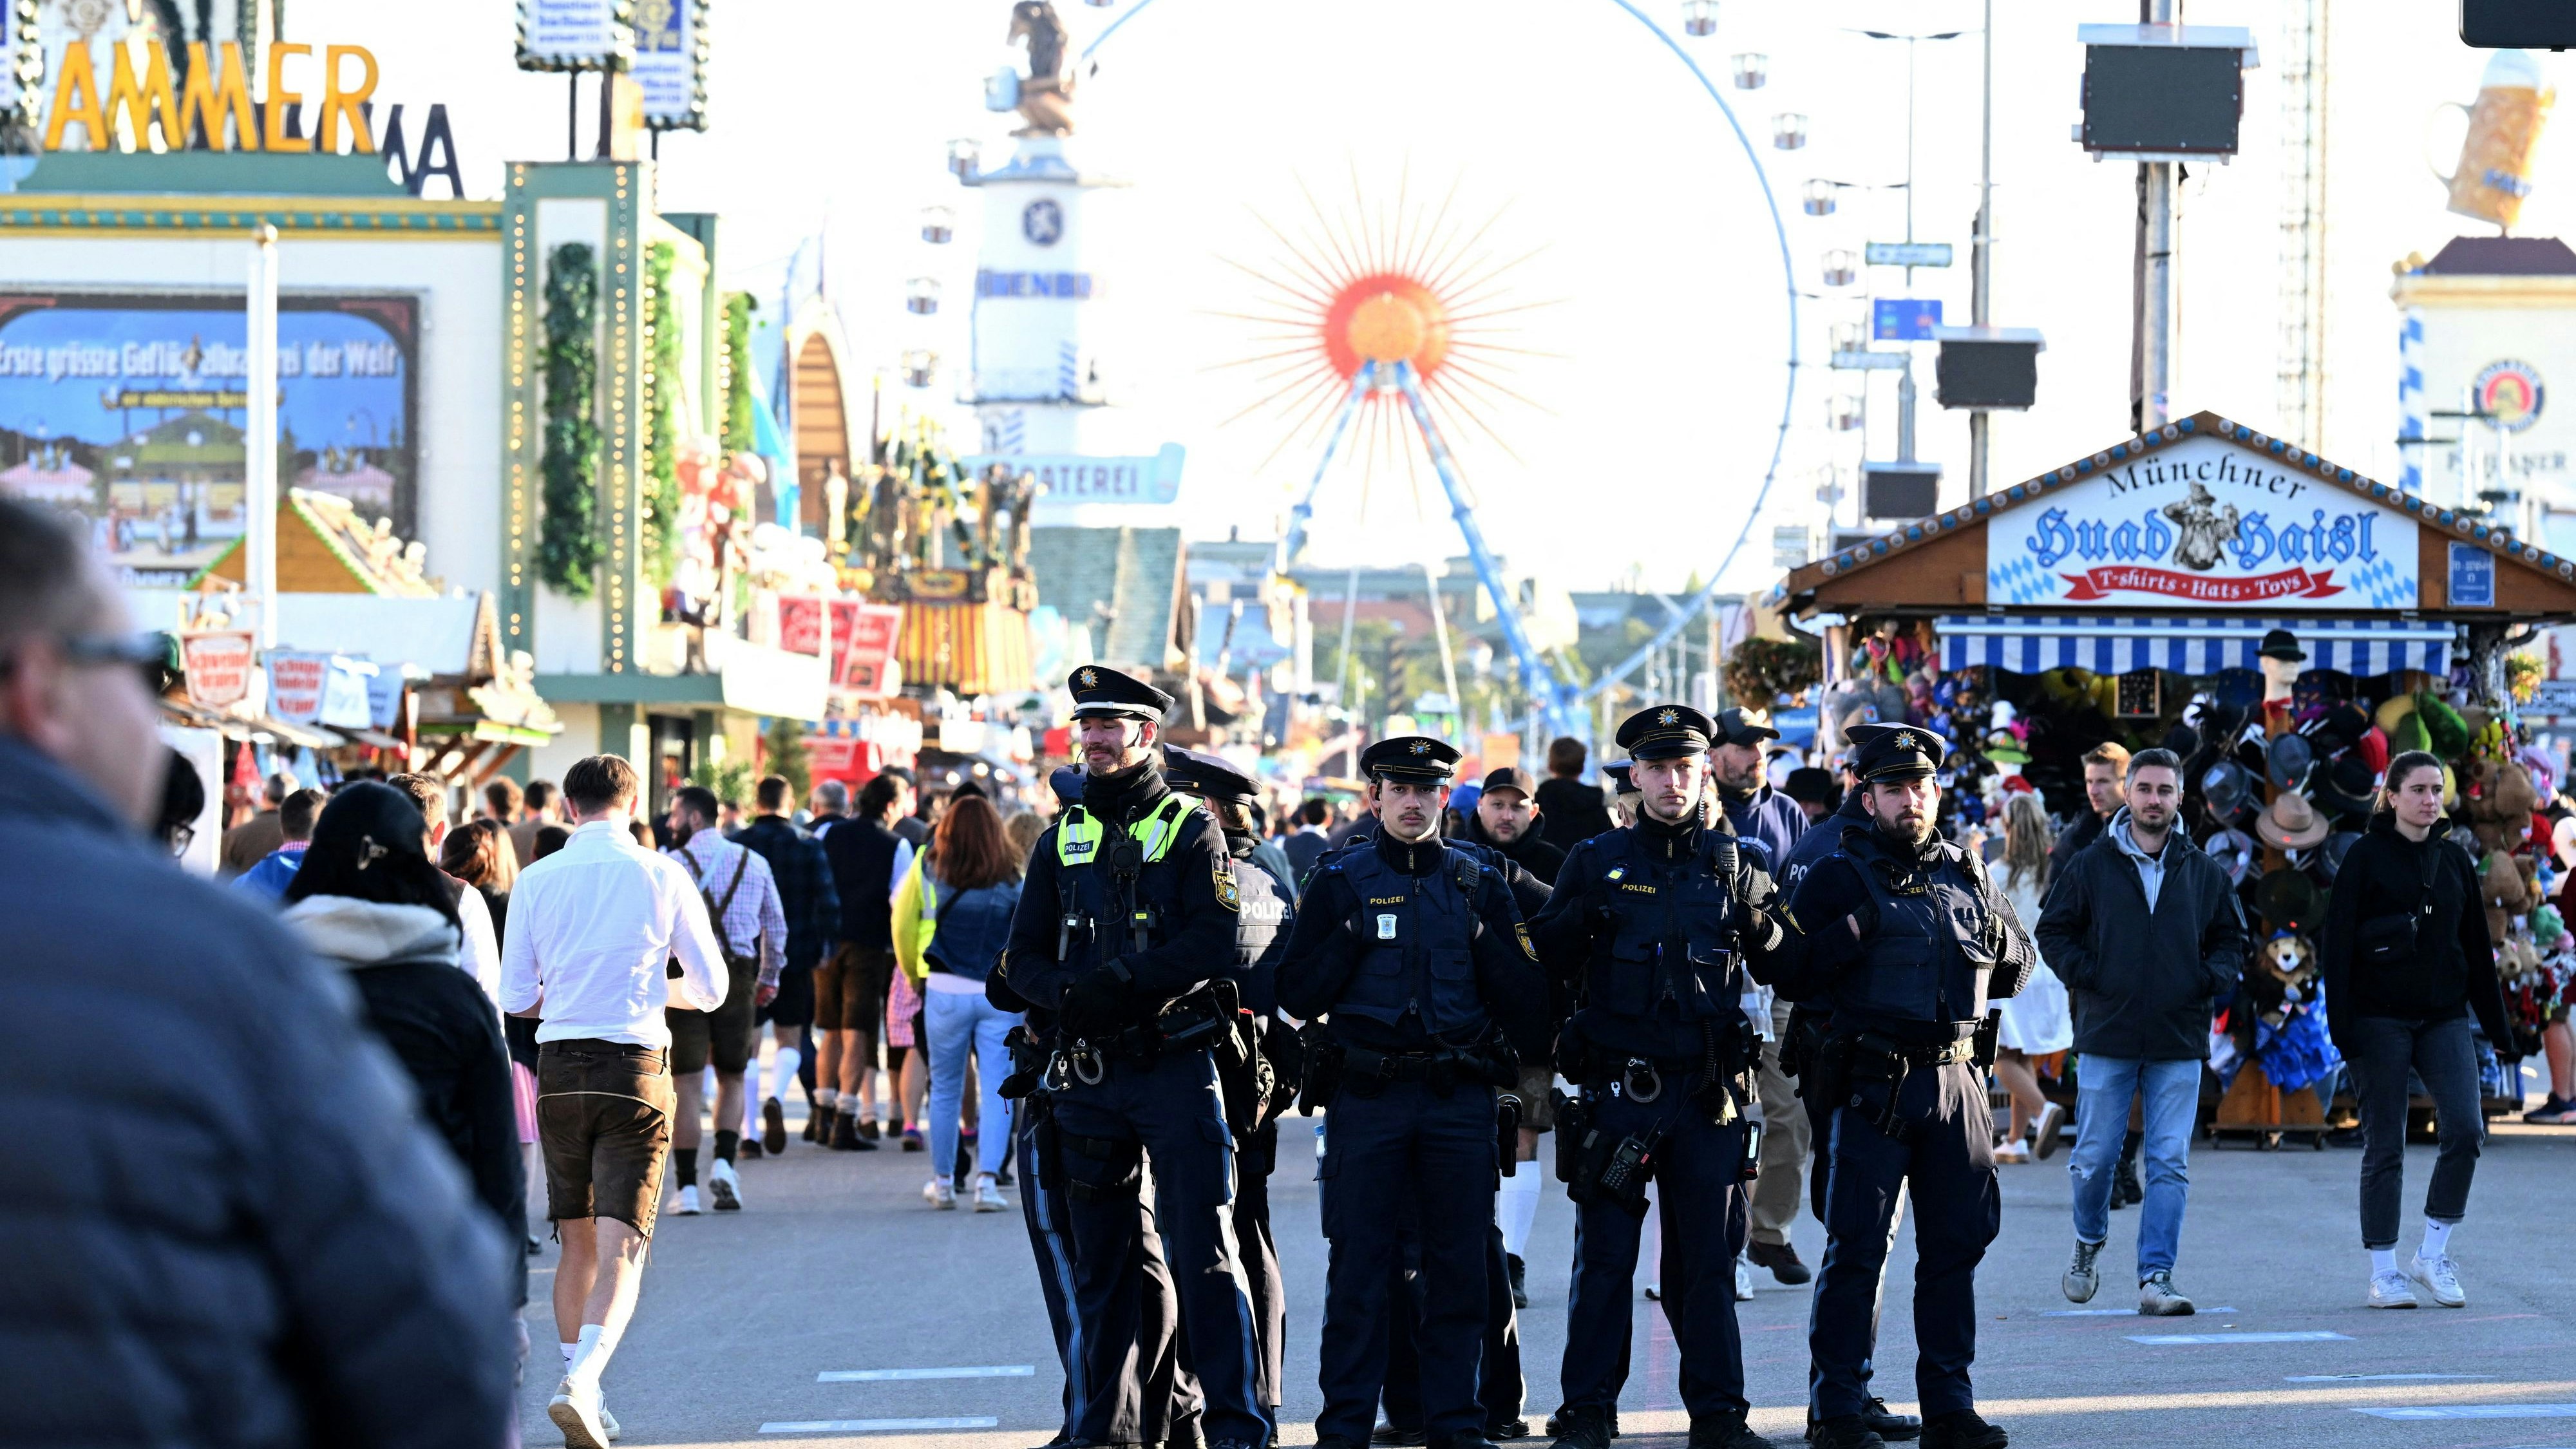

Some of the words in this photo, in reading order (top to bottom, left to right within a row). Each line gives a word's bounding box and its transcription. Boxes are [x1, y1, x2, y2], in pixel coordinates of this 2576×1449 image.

[43, 41, 379, 152] AMMER
[2104, 452, 2307, 500] Münchner
[2098, 568, 2178, 592] T-shirts
[2191, 580, 2240, 599] Hats
[2254, 574, 2302, 596] Toys
[1065, 842, 1090, 853] POLIZEI
[1622, 884, 1656, 894] POLIZEI
[1370, 895, 1404, 905] POLIZEI
[1240, 901, 1293, 920] POLIZEI
